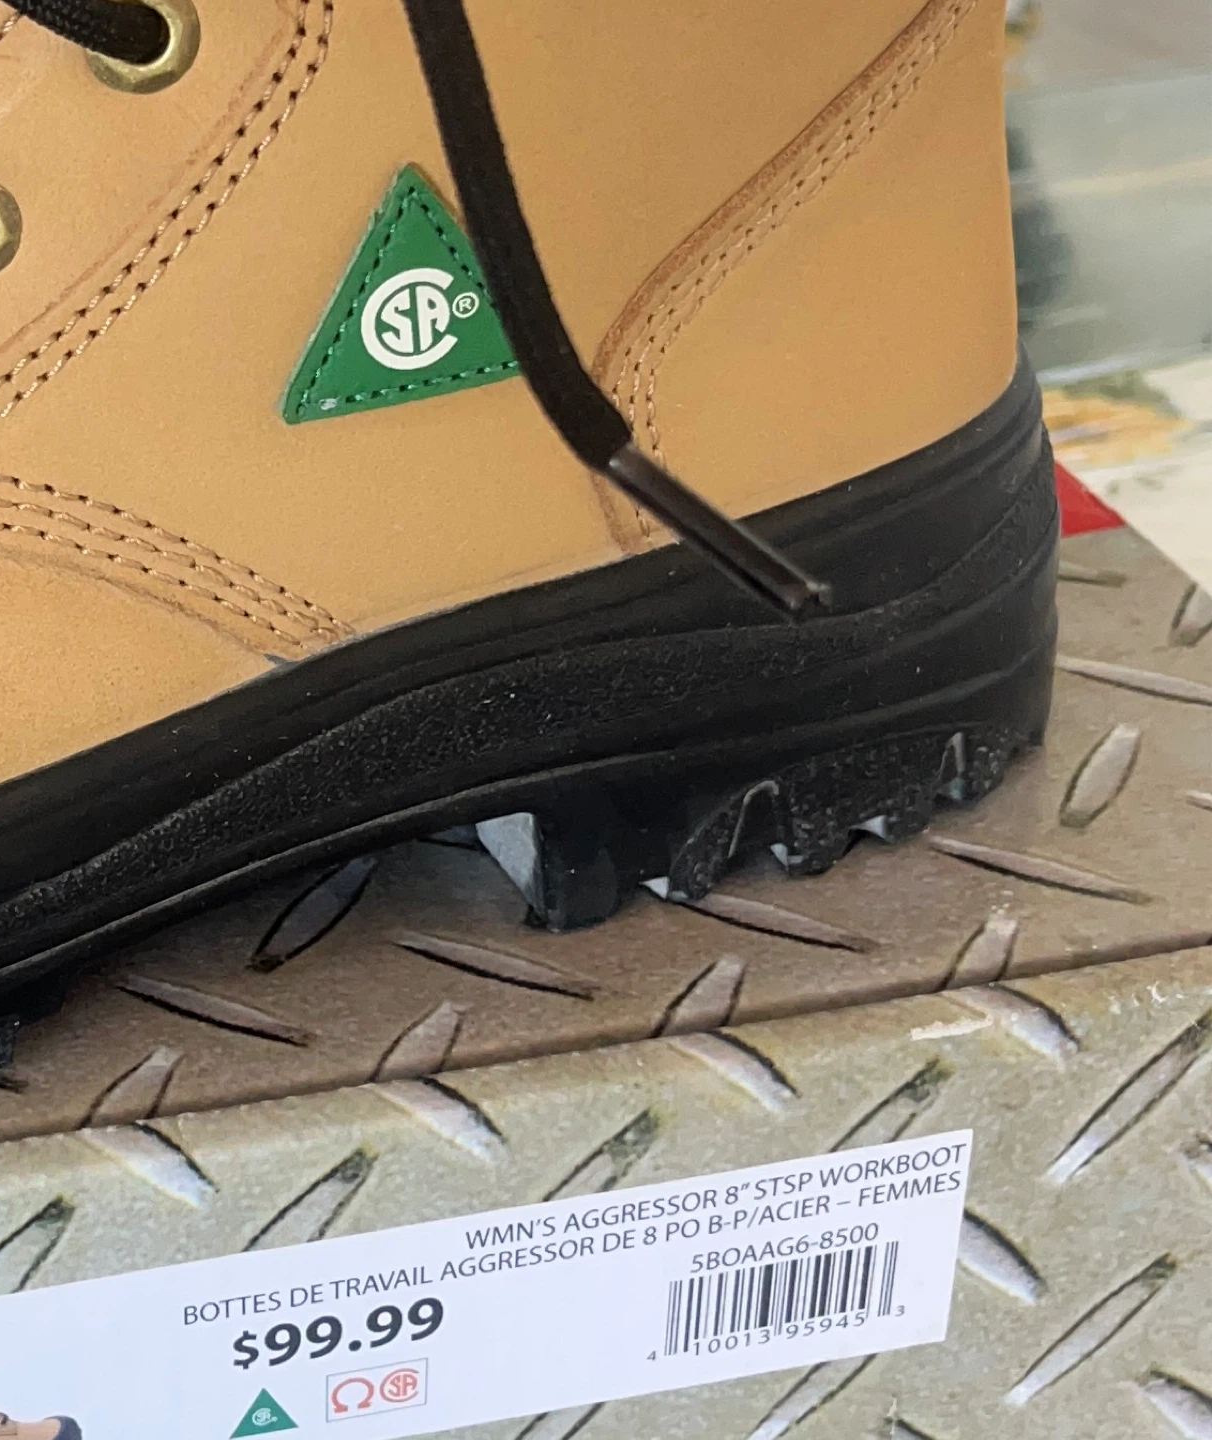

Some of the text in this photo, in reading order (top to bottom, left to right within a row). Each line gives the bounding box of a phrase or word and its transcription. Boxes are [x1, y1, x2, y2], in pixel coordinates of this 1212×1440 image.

[563, 1189, 718, 1234] AGGRESSOR
[753, 1172, 813, 1201] STSP
[819, 1143, 968, 1188] WORKBOOT
[183, 1291, 282, 1326] BOTTES
[290, 1283, 324, 1308] DE
[329, 1266, 433, 1300] TRAVAIL
[440, 1236, 595, 1281] AGGRESSOR
[602, 1229, 637, 1253] DE
[643, 1226, 658, 1246] 8
[665, 1219, 701, 1242] PO
[708, 1195, 831, 1236] B-P/ACIER
[858, 1171, 961, 1207] FEMMES
[689, 1222, 880, 1274] 5BOAAG6-8500
[233, 1297, 445, 1370] $99.99
[693, 1328, 771, 1356] 10013
[785, 1312, 866, 1340] 95945
